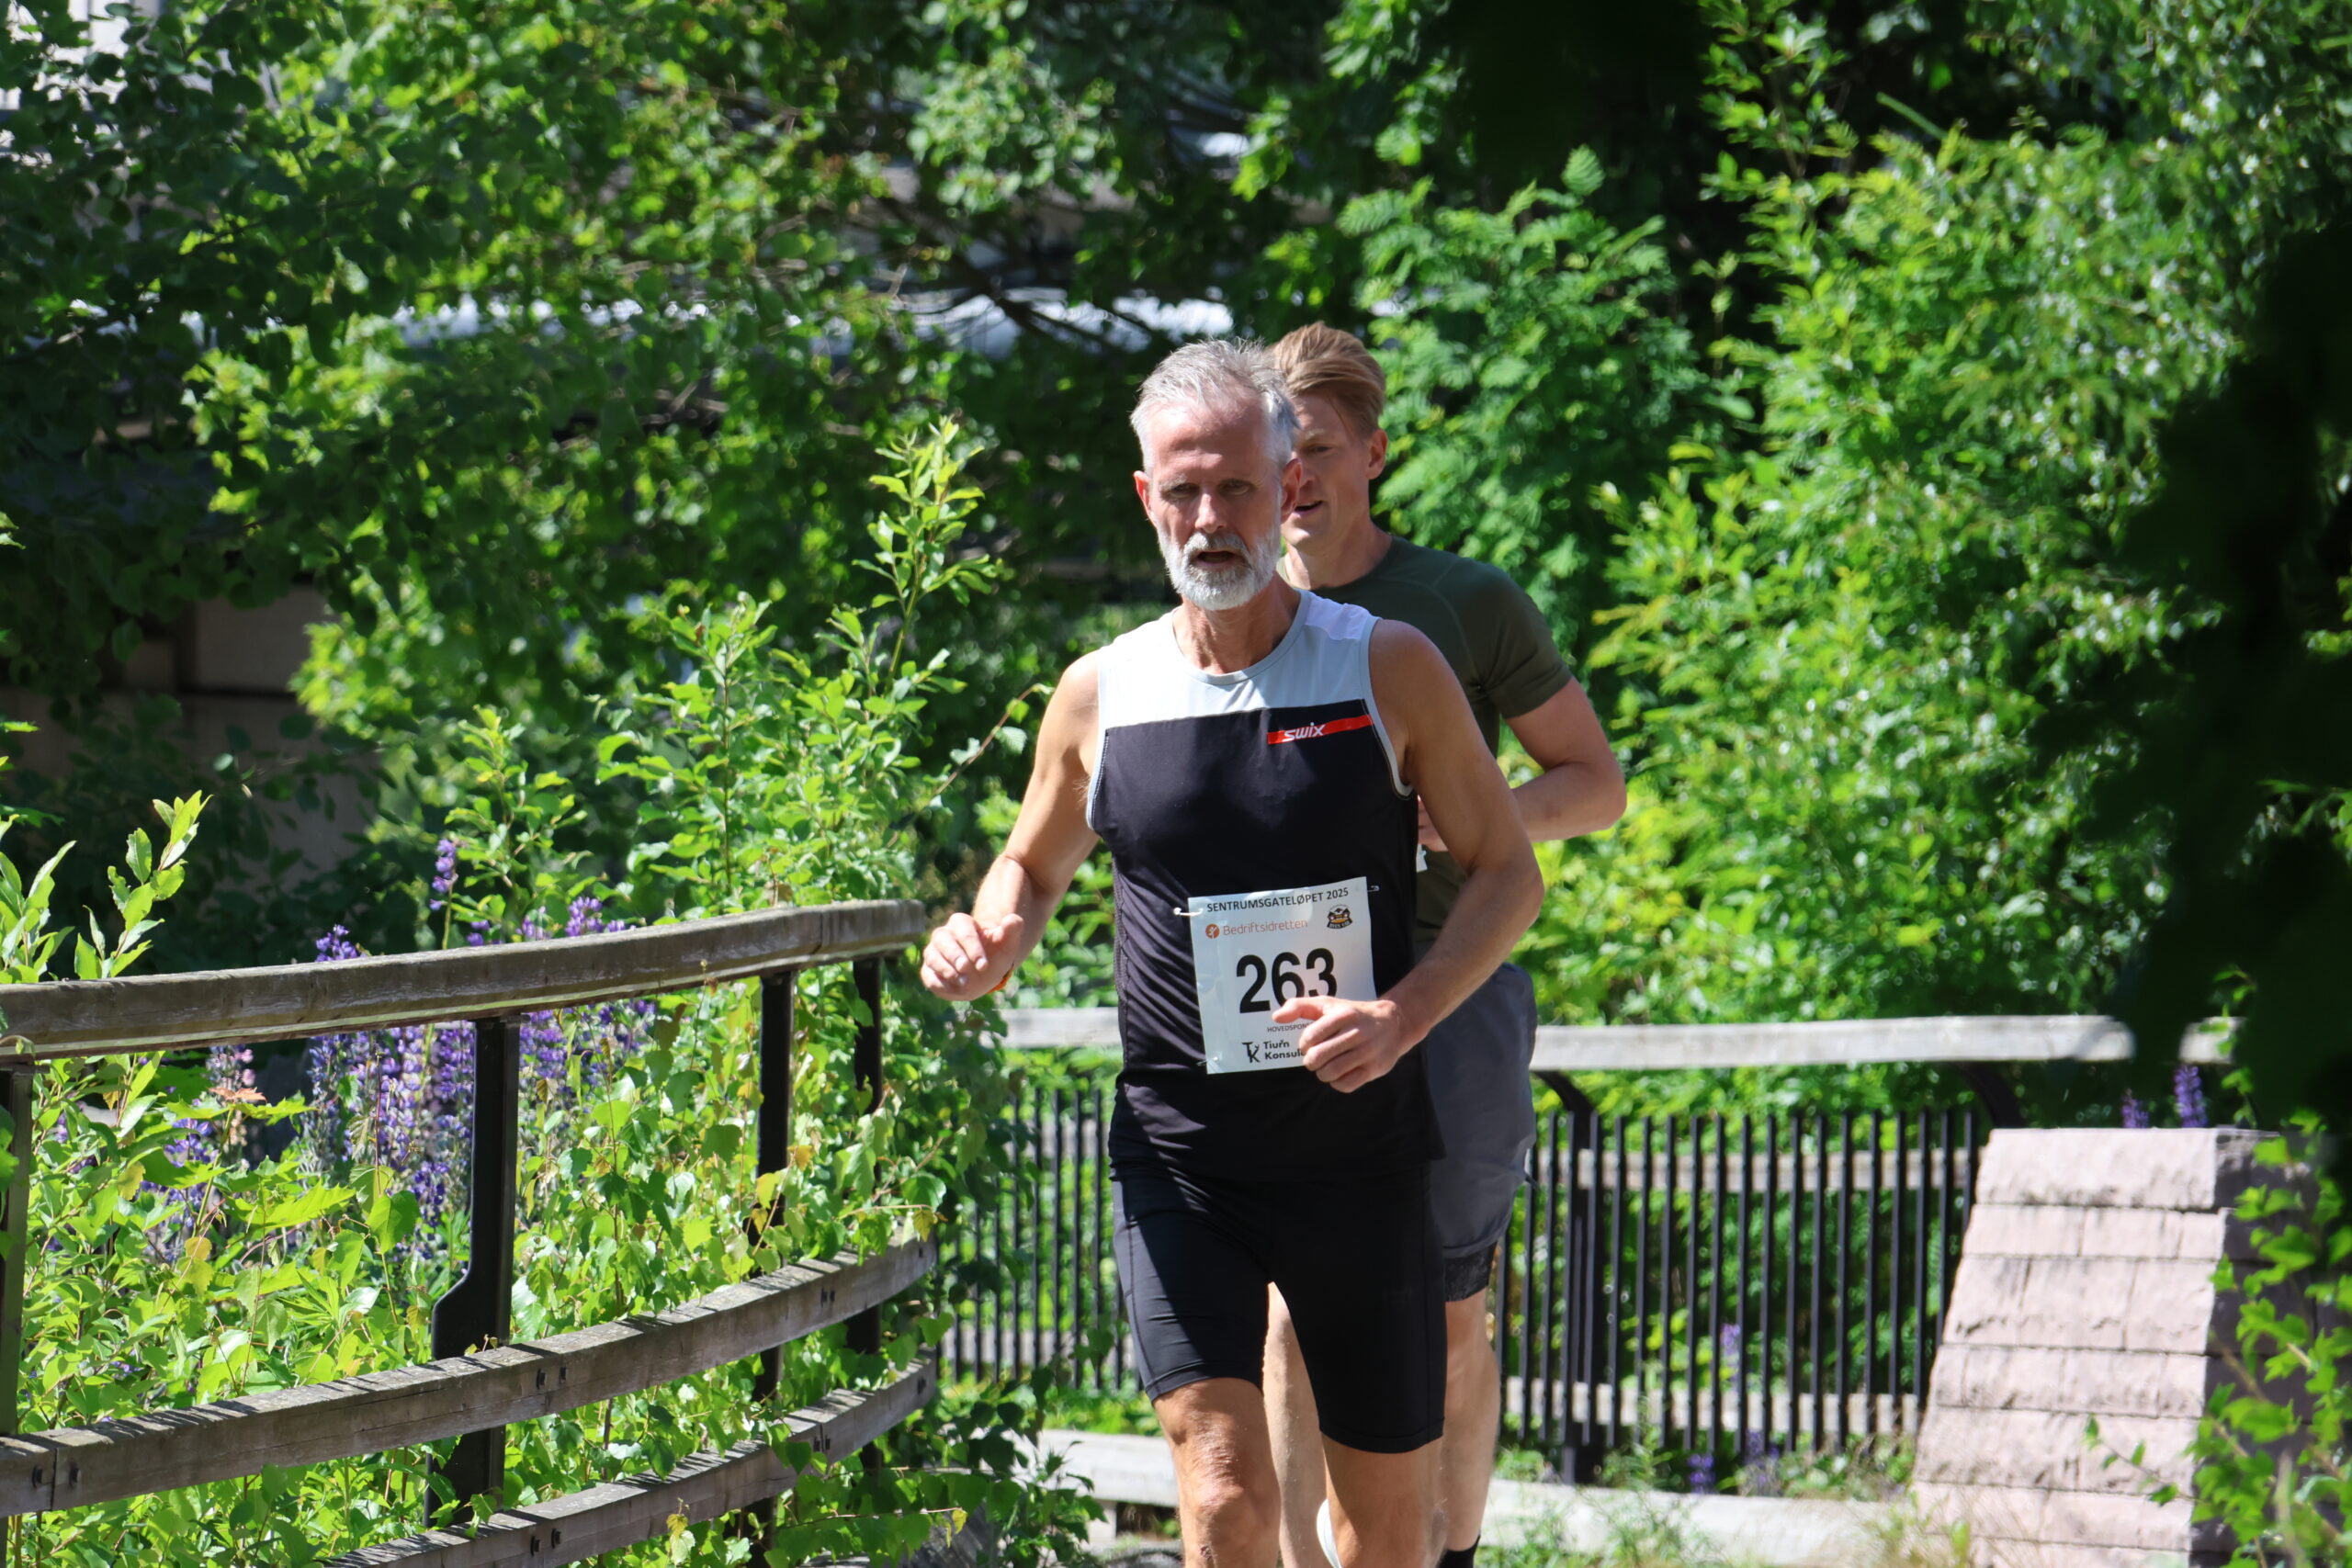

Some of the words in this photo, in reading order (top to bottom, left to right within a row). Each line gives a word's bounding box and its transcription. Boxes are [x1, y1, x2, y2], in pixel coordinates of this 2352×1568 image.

[1206, 892, 1324, 913] SENTRUMSGATELØPET
[1326, 887, 1349, 900] 2025
[1223, 919, 1308, 935] Bedriftsidretten
[1236, 948, 1338, 1014] 263
[1267, 1022, 1309, 1032] HOVEDSPON
